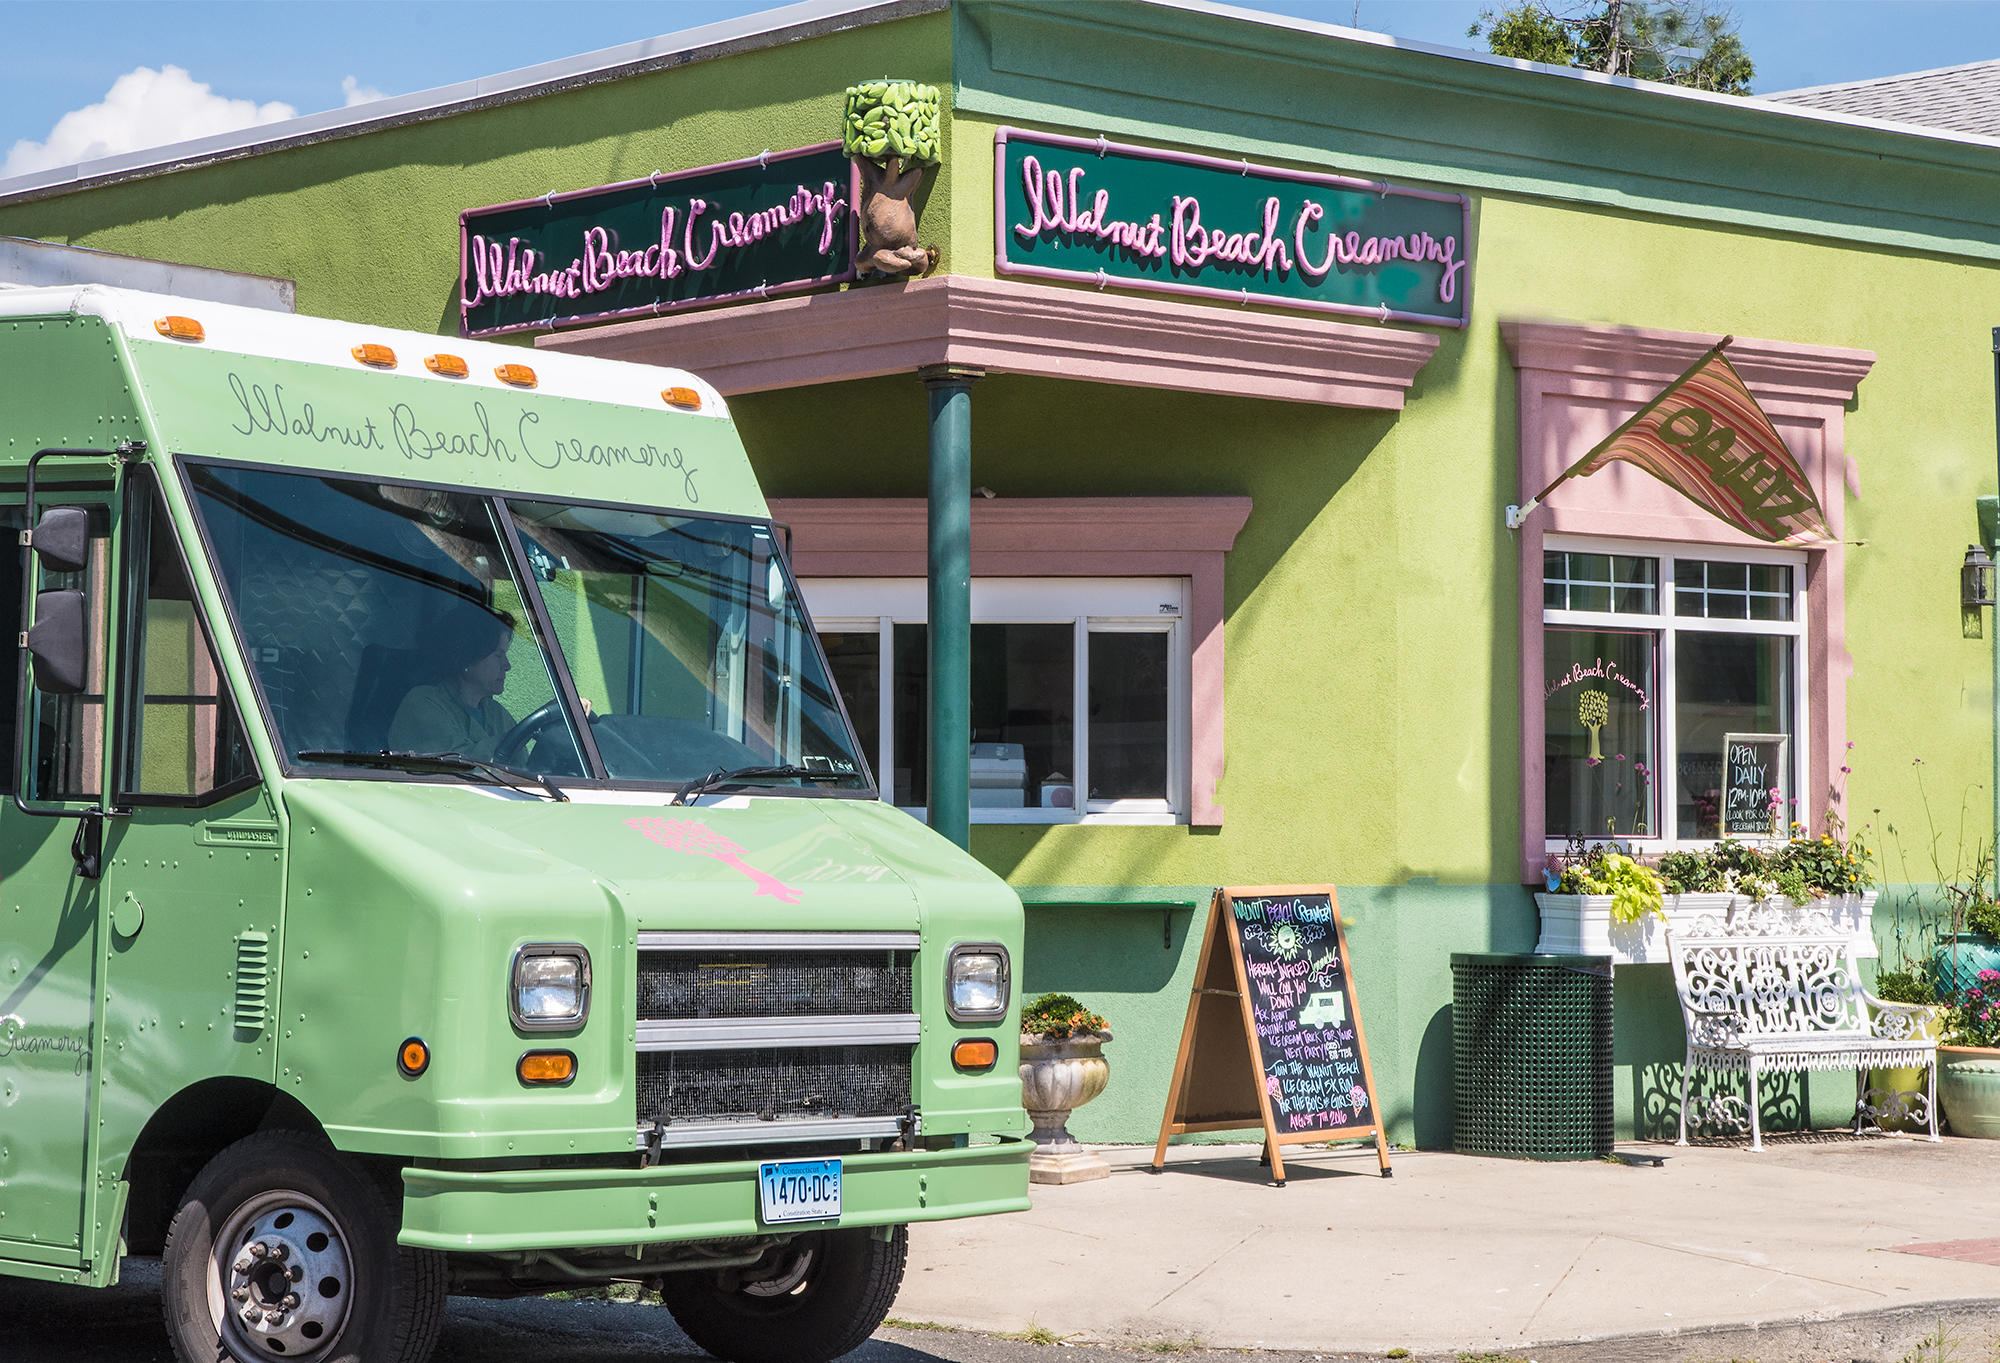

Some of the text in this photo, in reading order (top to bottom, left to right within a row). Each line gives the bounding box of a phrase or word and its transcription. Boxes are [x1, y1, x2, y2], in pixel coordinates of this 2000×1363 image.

[1014, 155, 1466, 303] Walnut Beach Creamery
[461, 181, 847, 308] Walnut Beach Creamery
[227, 373, 699, 503] Walnut Beach Creamery
[1658, 408, 1814, 541] OPEN
[1572, 657, 1605, 682] Beach
[1606, 661, 1650, 711] Creamery
[1729, 744, 1758, 765] OPEN
[1735, 763, 1767, 789] DAILY
[1745, 809, 1758, 820] FOR
[1232, 898, 1335, 931] WALNUT BEACH CREAMERY
[1246, 953, 1277, 979] HERBAL
[1273, 956, 1311, 983] INFUSED
[1256, 977, 1277, 995] WILL
[1293, 978, 1307, 1005] YOU
[1254, 1003, 1291, 1022] ASK ABOUT
[1269, 994, 1295, 1010] DOWN
[1256, 1020, 1298, 1038] RENTING OUR
[1268, 1028, 1354, 1047] ICE CREAM TRUCK FOR YOUR
[1284, 1046, 1303, 1060] NEXT
[1265, 1058, 1360, 1079] JOIN THE WALNUT BEACH
[1282, 1075, 1354, 1097] ICE CREAM 5K RUN
[1278, 1097, 1292, 1116] FOR
[1290, 1093, 1305, 1111] THE
[1305, 1095, 1324, 1113] BOYS
[1330, 1093, 1353, 1111] GIRLS
[1290, 1113, 1316, 1131] AUGUST
[1329, 1110, 1348, 1127] 2016
[782, 1166, 819, 1175] Connecticut
[782, 1207, 823, 1217] Constitution State
